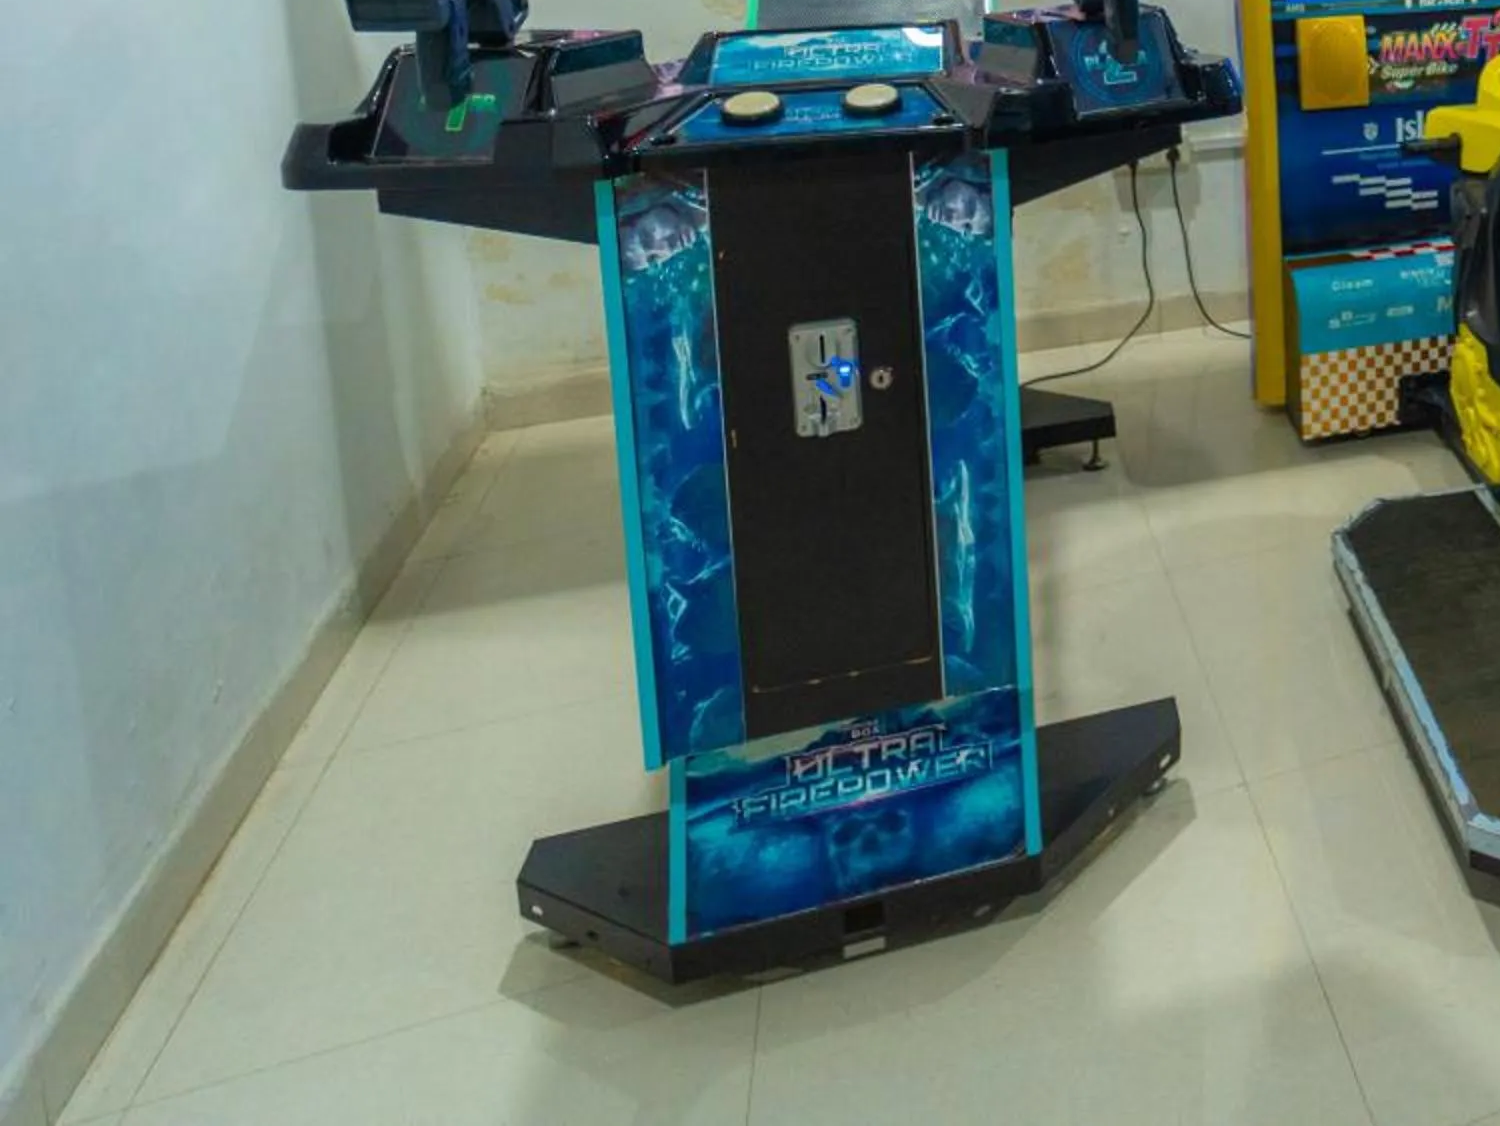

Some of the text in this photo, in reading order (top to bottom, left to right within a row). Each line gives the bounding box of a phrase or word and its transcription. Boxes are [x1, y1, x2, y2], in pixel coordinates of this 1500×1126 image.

[1379, 33, 1458, 62] MANX
[1395, 110, 1425, 142] Isl
[743, 747, 986, 819] FIREPOWER
